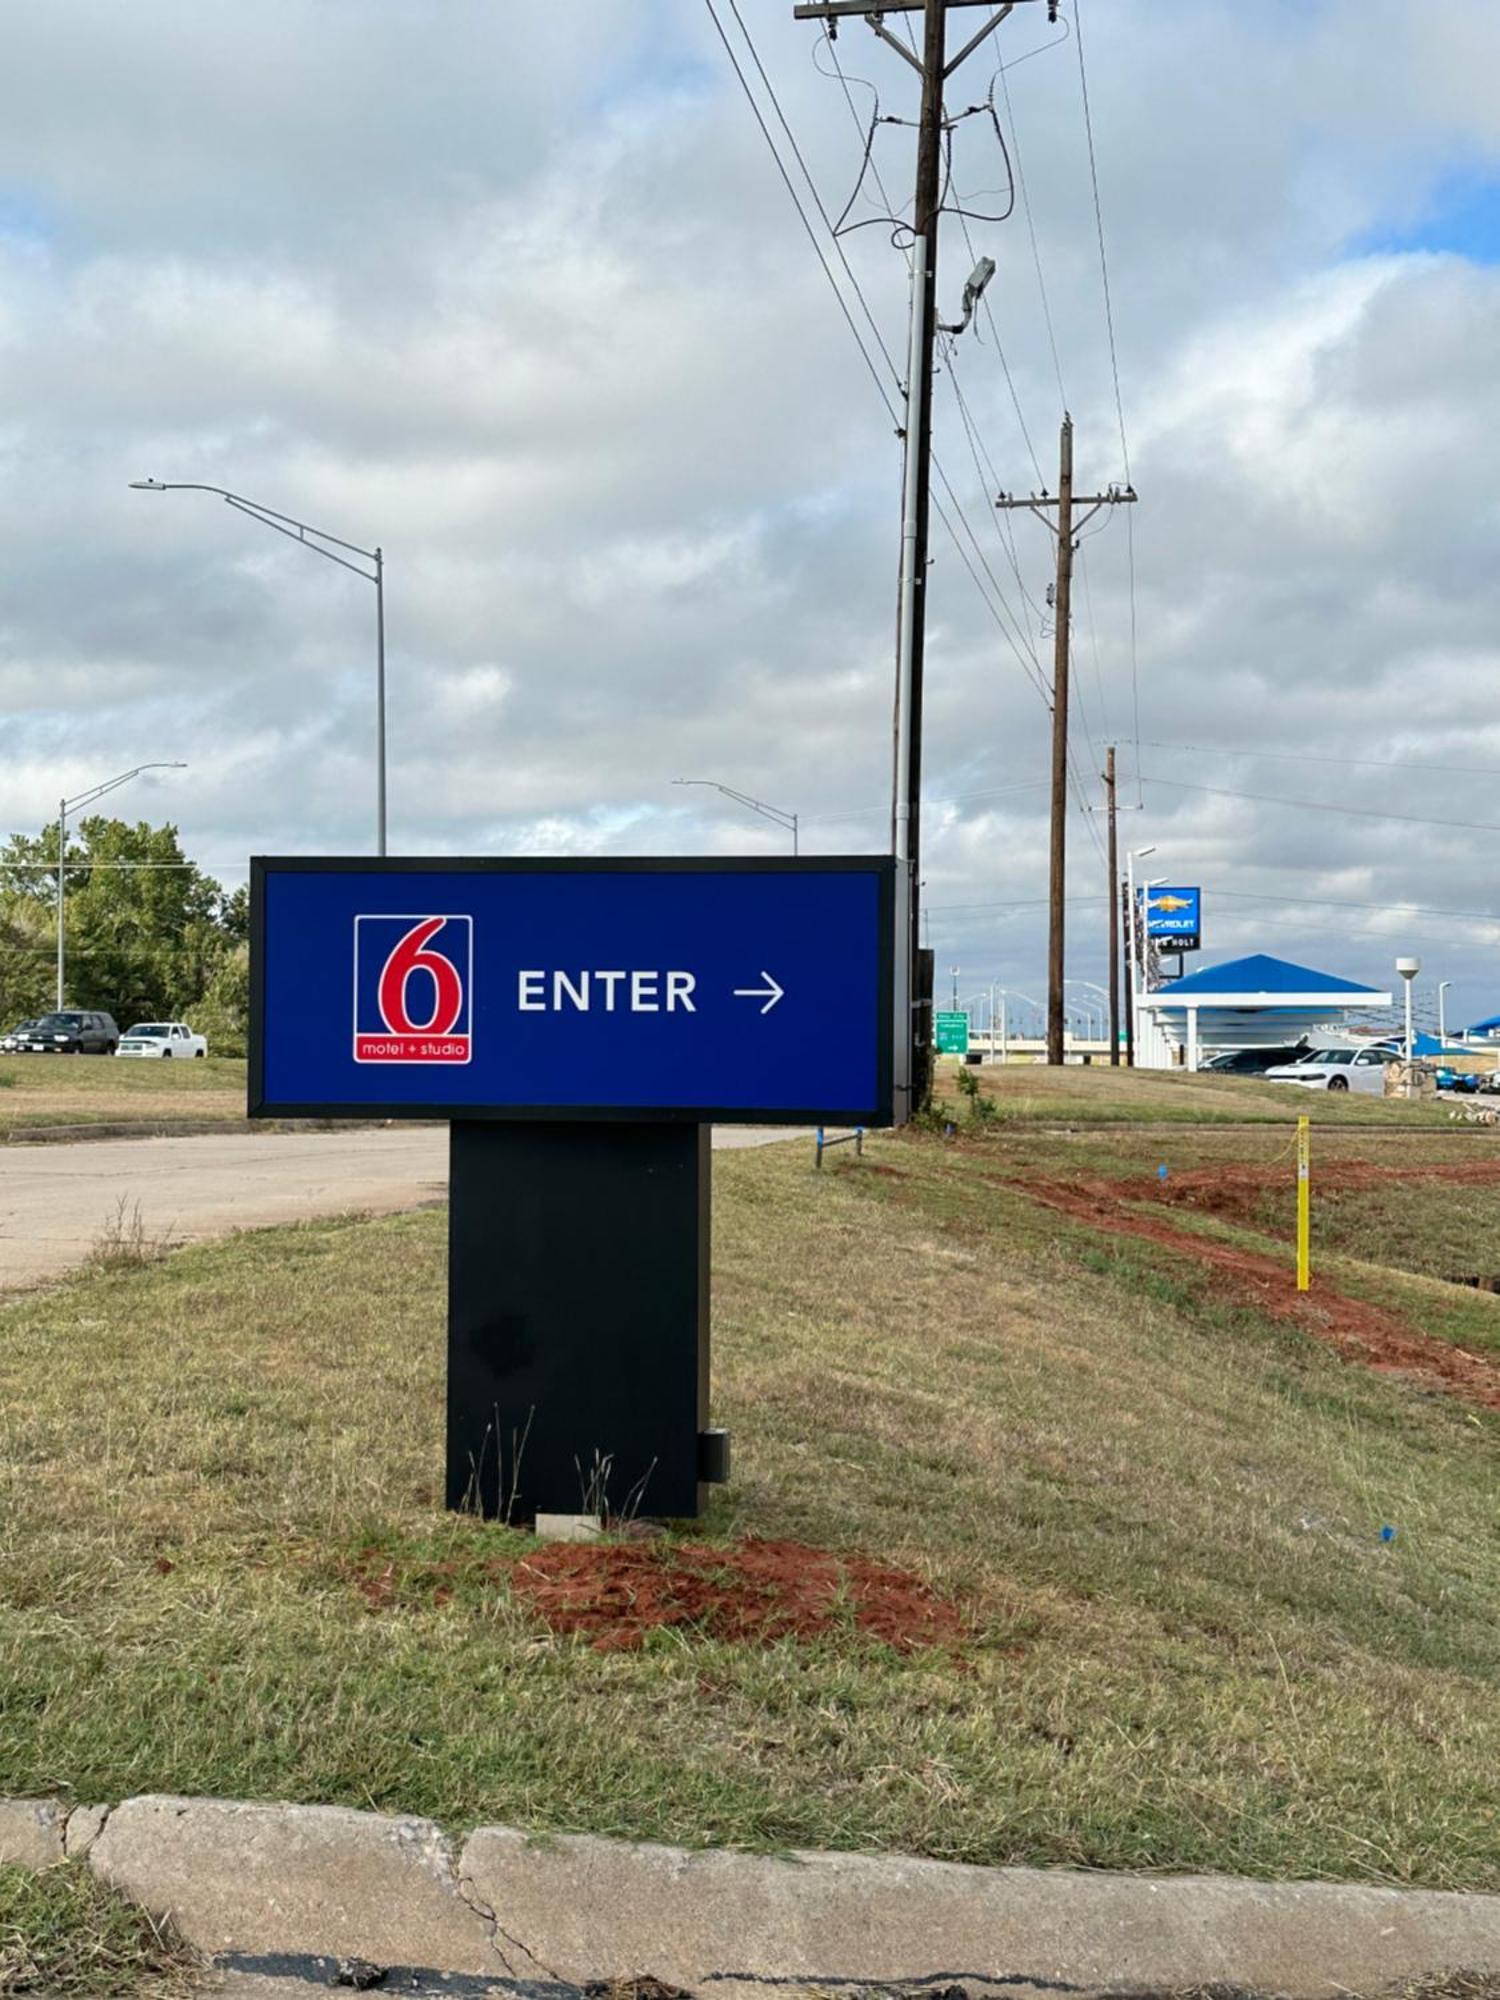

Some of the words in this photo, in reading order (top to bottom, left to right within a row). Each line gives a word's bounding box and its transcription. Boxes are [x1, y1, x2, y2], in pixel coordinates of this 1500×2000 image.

[377, 916, 463, 1037] 6
[518, 970, 697, 1012] ENTER
[362, 1042, 404, 1055] motel
[420, 1042, 465, 1056] studio
